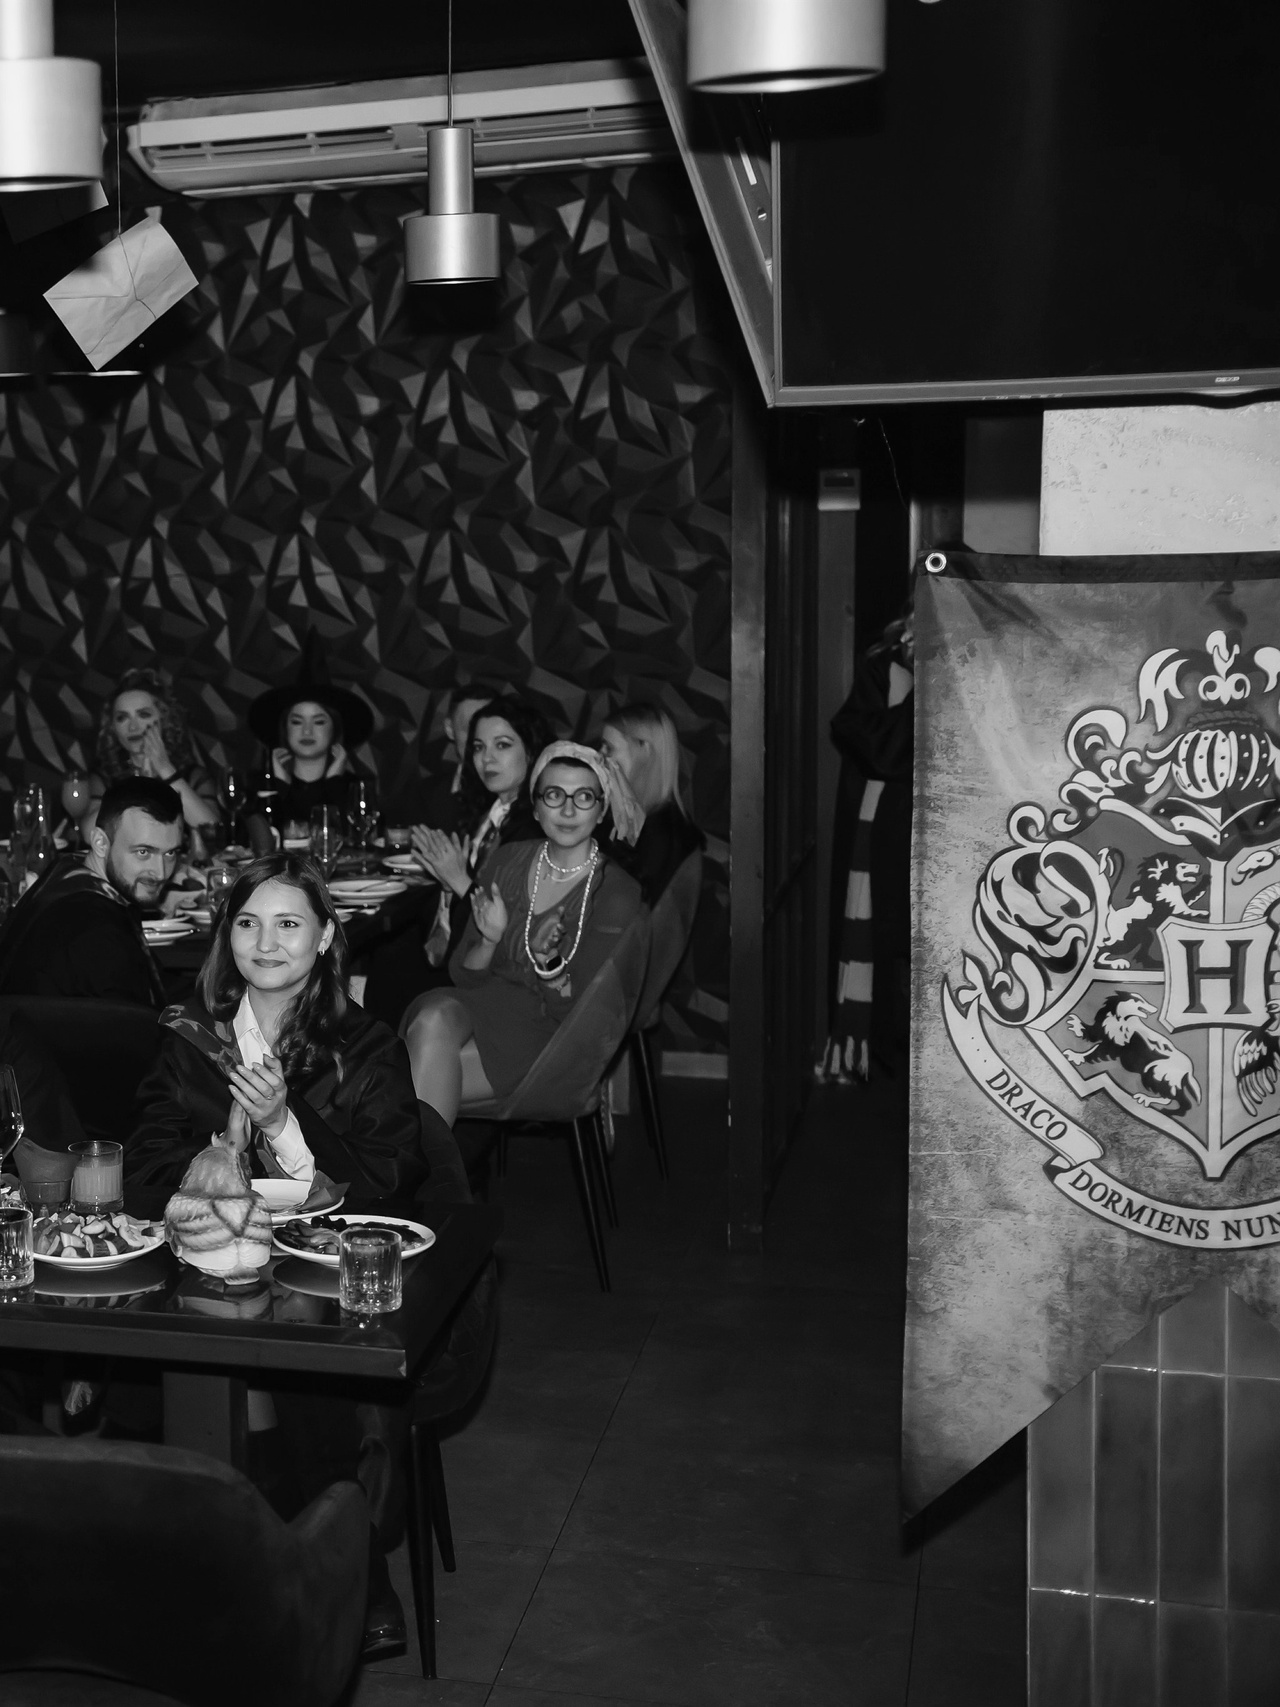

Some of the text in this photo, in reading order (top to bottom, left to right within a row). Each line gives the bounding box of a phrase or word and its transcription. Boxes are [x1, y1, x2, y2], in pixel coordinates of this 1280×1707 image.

[1177, 939, 1254, 1015] H
[985, 1068, 1069, 1141] DRACO
[1068, 1168, 1210, 1241] DORMIENS
